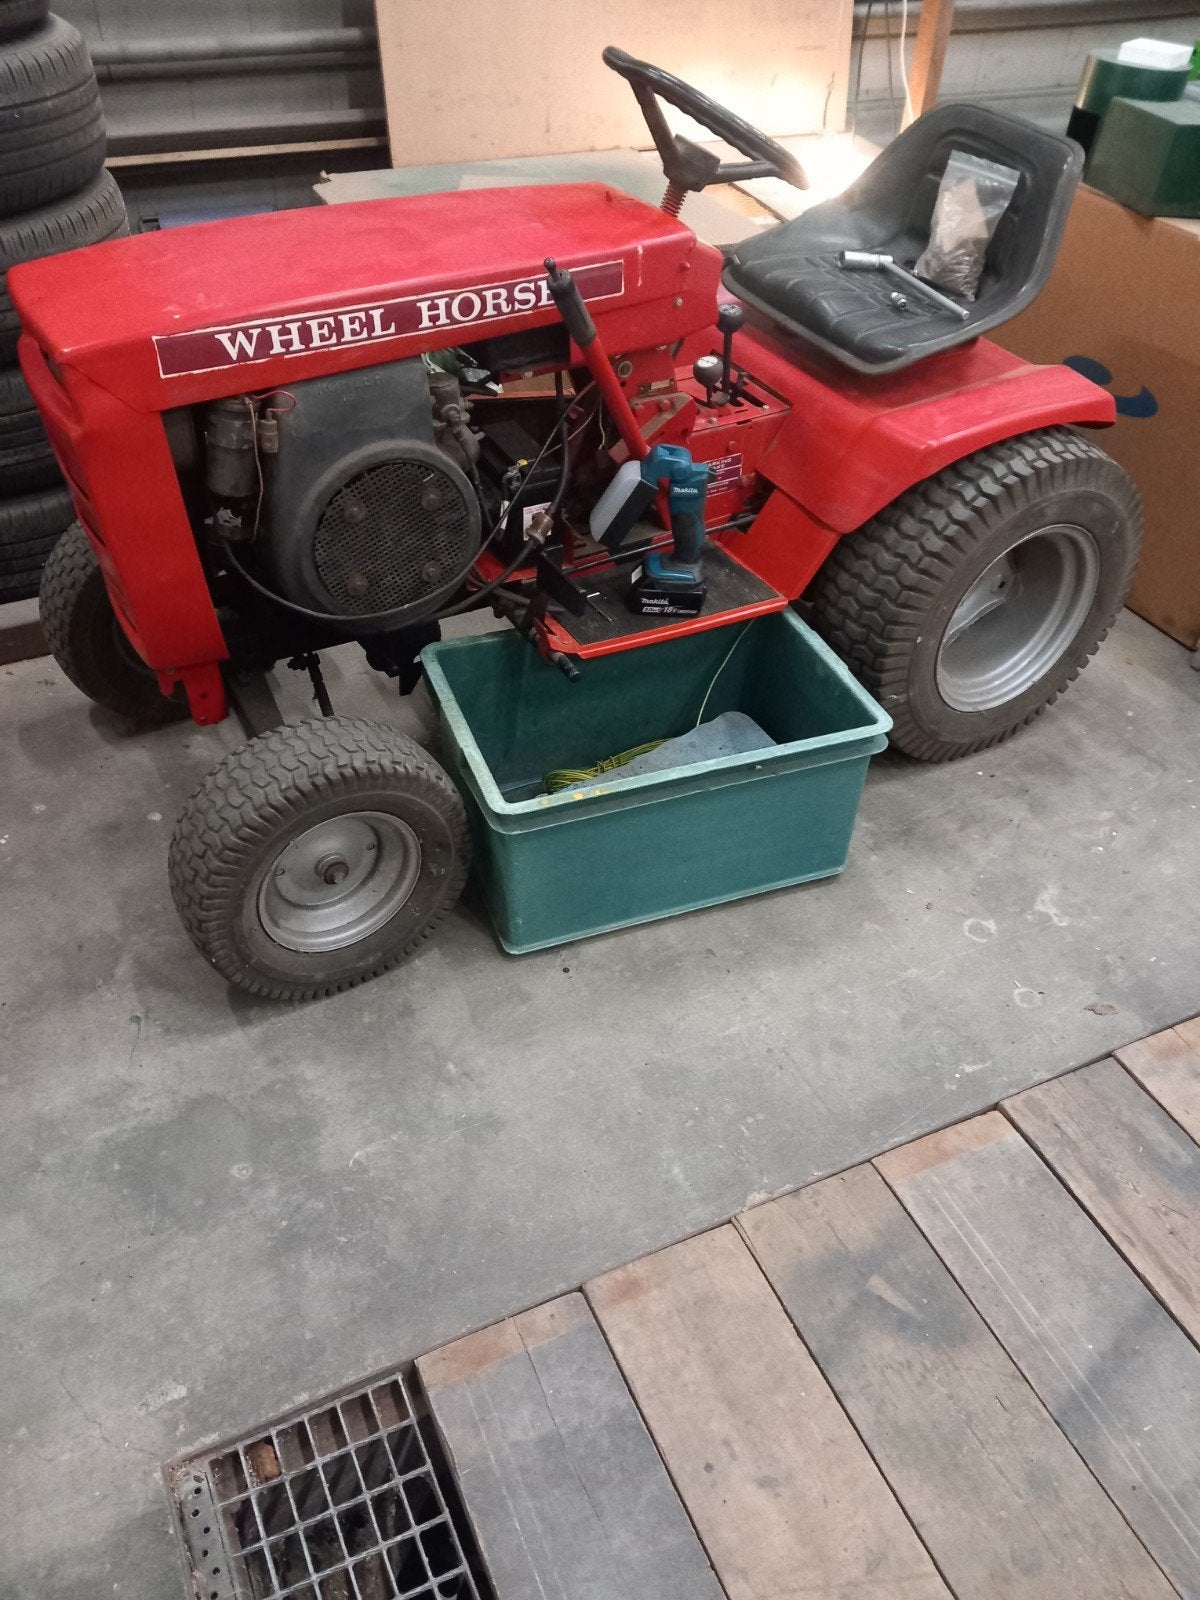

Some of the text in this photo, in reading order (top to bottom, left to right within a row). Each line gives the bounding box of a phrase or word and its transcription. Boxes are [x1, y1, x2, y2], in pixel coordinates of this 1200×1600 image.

[215, 279, 557, 362] WHEEL HORSE
[708, 457, 732, 467] ARKING
